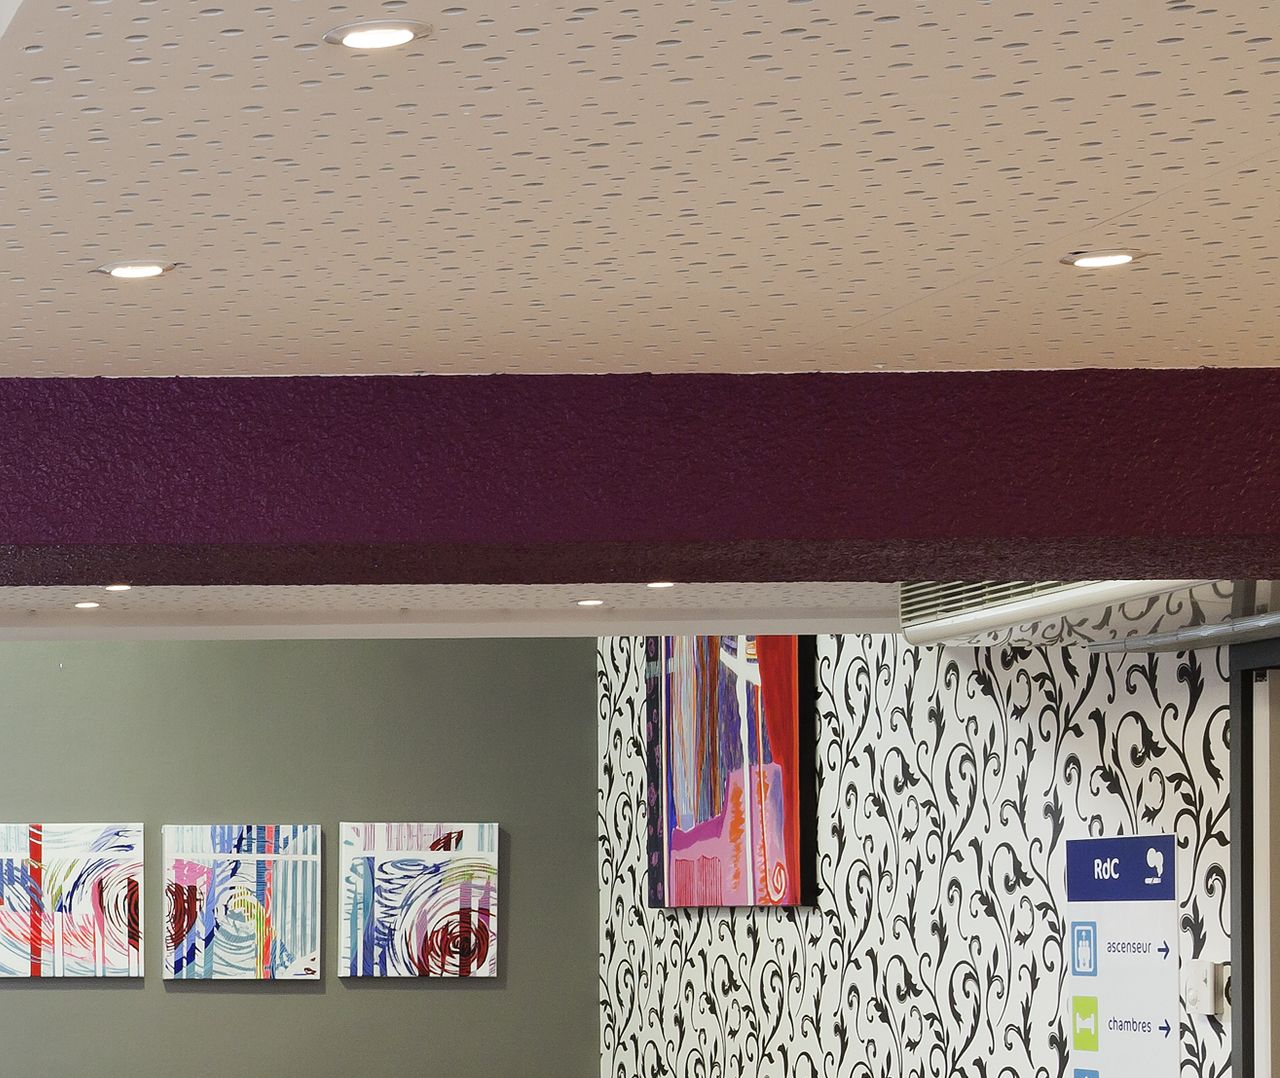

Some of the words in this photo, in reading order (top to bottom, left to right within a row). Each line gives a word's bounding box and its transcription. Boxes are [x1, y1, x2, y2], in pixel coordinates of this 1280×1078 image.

[1094, 858, 1120, 879] RdC
[1107, 942, 1151, 953] ascenseur
[1108, 1016, 1152, 1033] chambres
